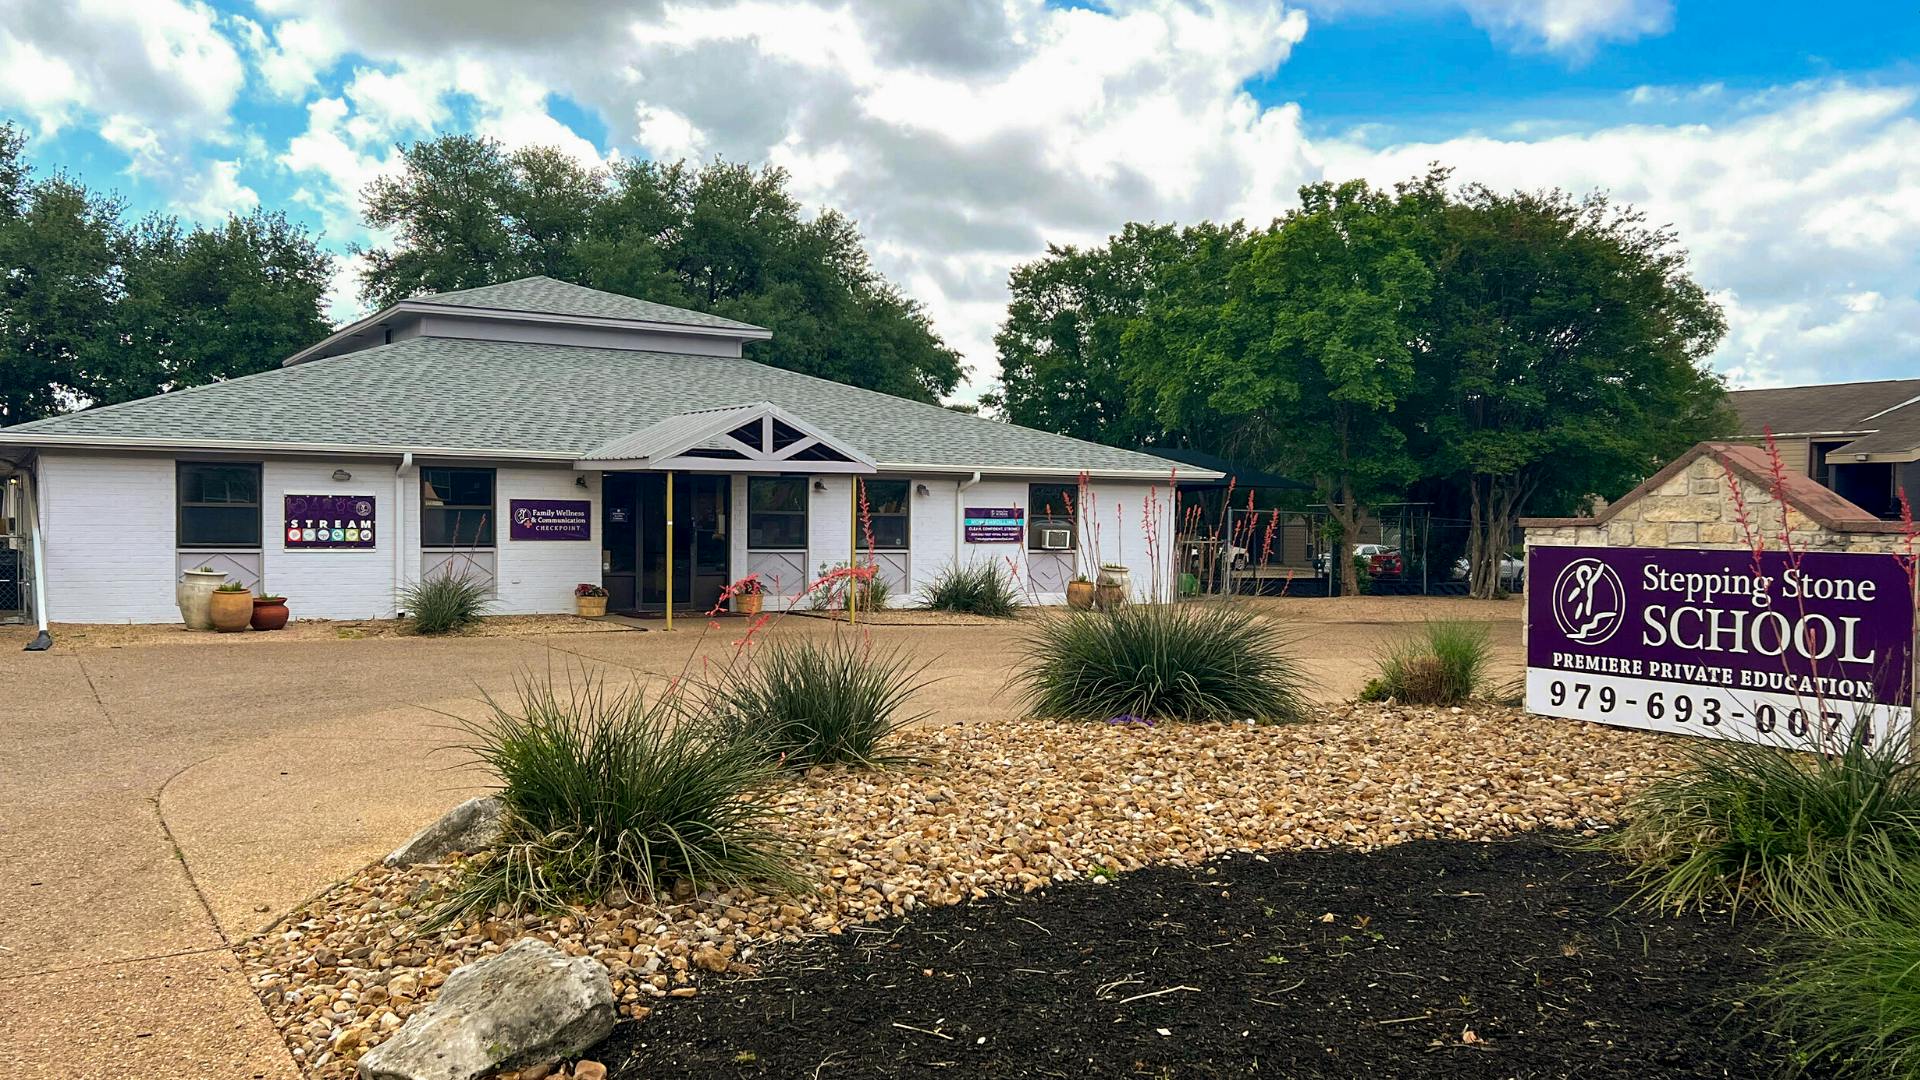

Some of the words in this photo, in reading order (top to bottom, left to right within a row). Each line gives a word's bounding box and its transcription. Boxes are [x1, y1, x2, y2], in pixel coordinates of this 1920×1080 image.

[290, 520, 371, 528] STREAM
[532, 509, 555, 517] Family
[1643, 564, 1774, 607] Stepping
[1782, 568, 1876, 601] Stone
[1643, 604, 1875, 664] SCHOOL
[1553, 652, 1643, 676] PREMIERE
[1650, 661, 1733, 685] PRIVATE
[1741, 670, 1873, 699] EDUCATION
